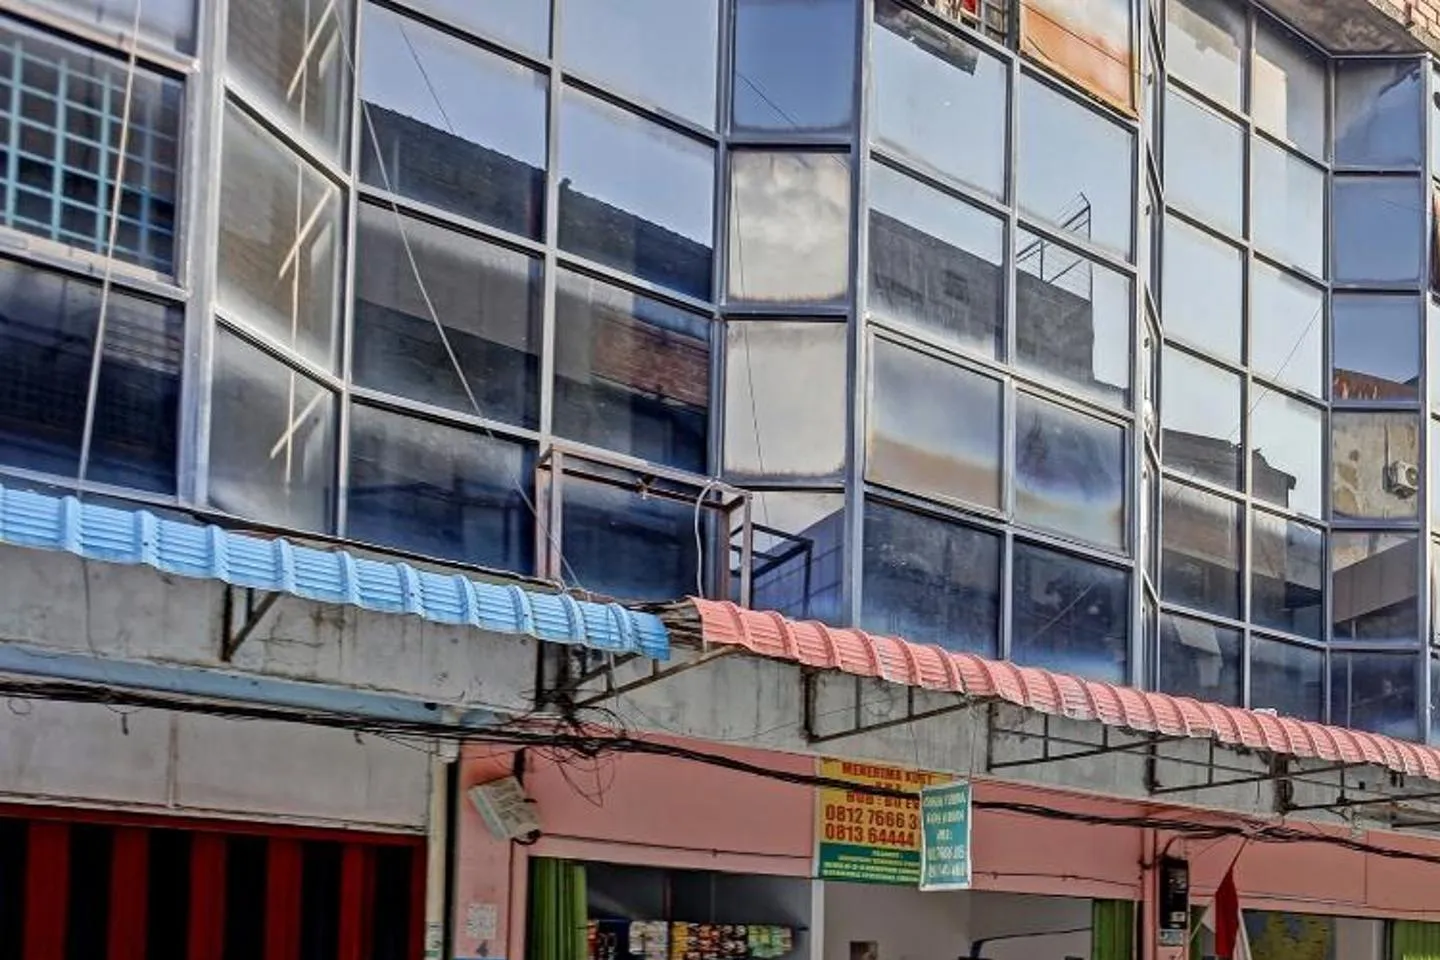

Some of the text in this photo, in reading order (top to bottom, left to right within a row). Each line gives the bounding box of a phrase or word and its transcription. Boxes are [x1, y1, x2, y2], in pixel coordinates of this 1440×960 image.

[825, 803, 864, 825] 0812
[867, 809, 905, 829] 7666
[825, 822, 864, 843] 0813
